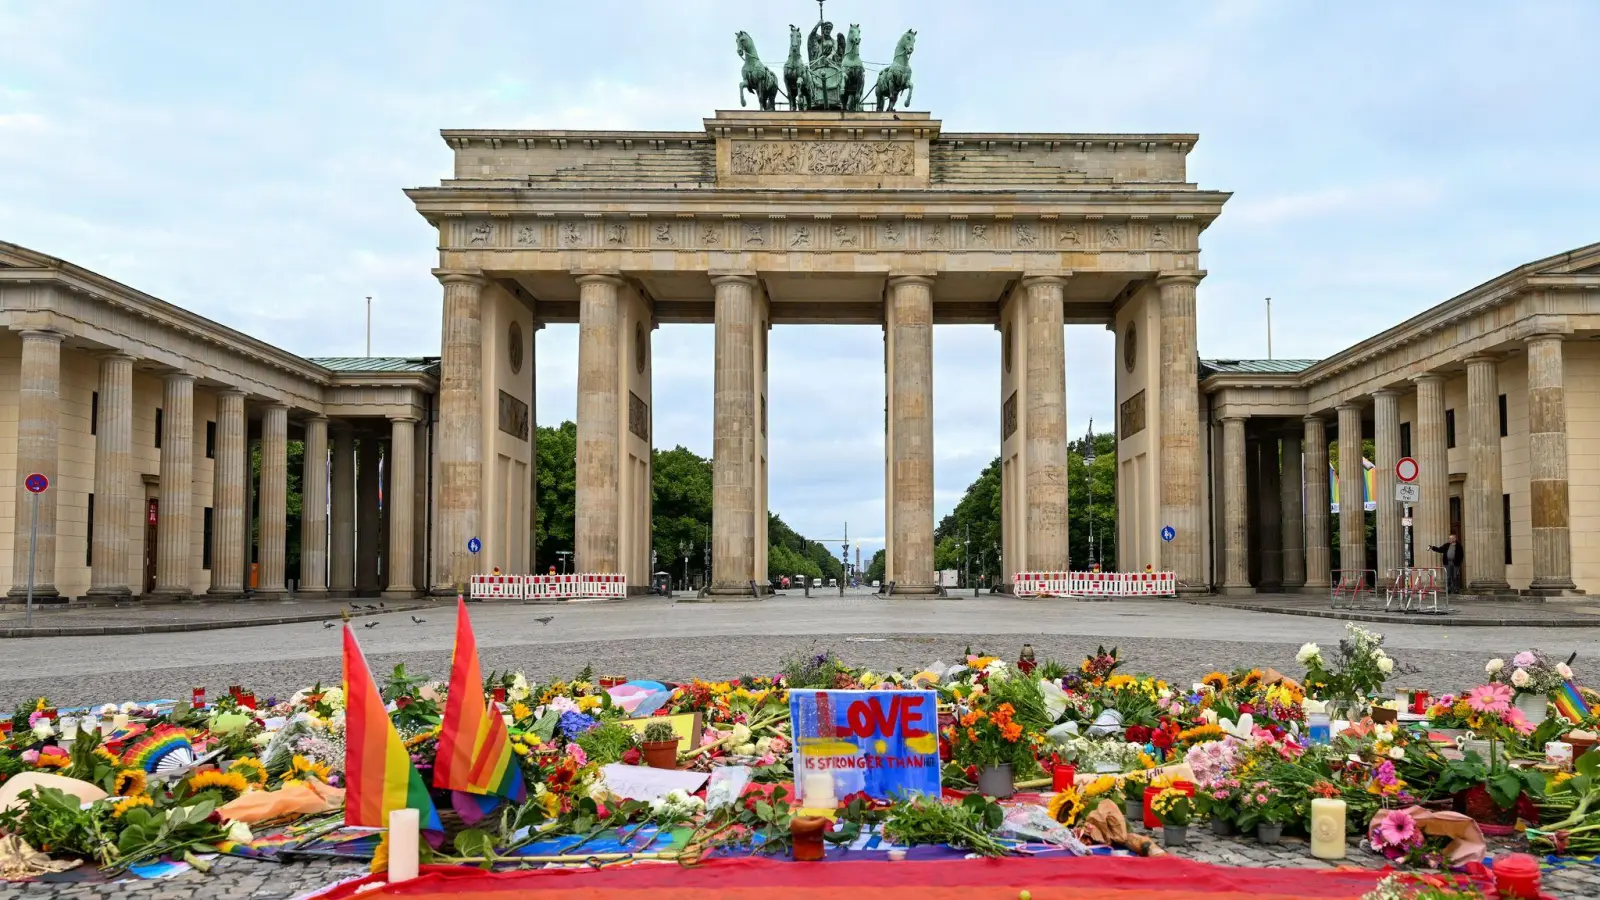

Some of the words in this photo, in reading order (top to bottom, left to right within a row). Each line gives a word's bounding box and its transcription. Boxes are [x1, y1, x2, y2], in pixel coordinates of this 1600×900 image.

[815, 692, 929, 738] LOVE
[805, 757, 815, 769] IS
[818, 755, 883, 770] STRONGER
[887, 755, 923, 769] THAN
